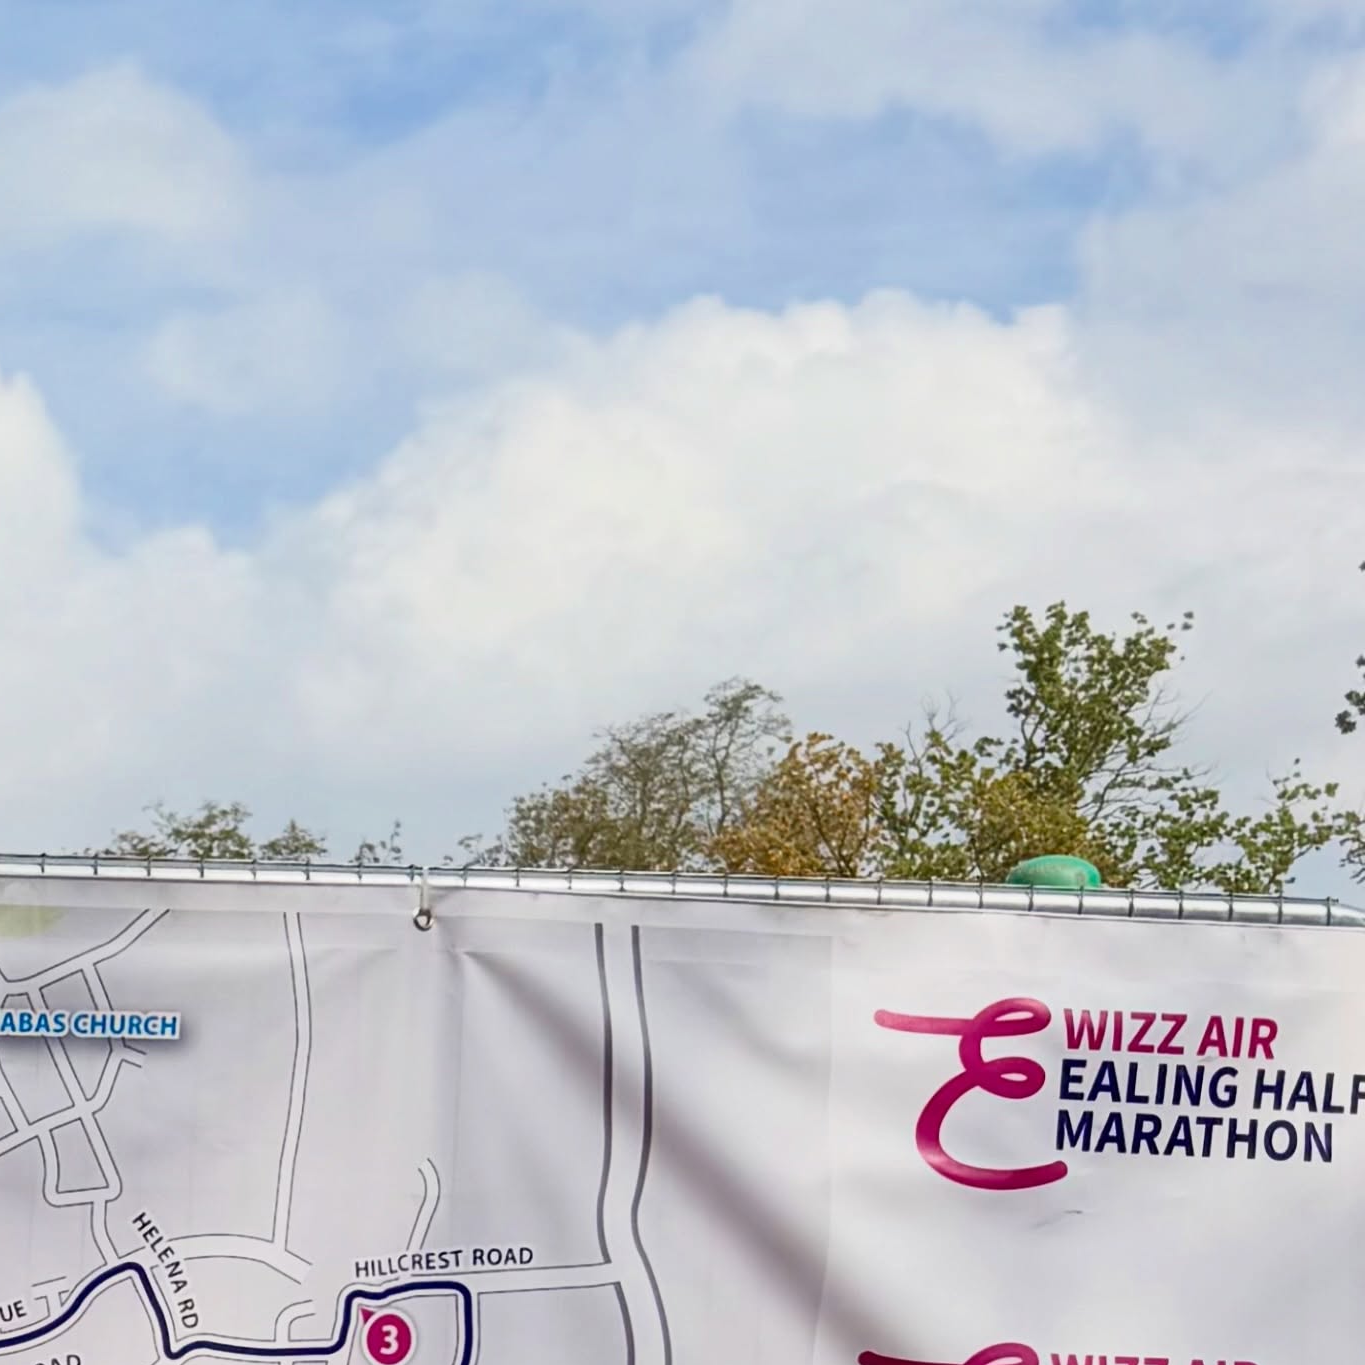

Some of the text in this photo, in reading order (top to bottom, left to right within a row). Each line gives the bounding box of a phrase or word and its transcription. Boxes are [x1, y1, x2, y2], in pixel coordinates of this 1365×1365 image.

[74, 1015, 177, 1036] CHURCH
[355, 1247, 534, 1278] HILLCREST ROAD
[380, 1324, 399, 1355] 3
